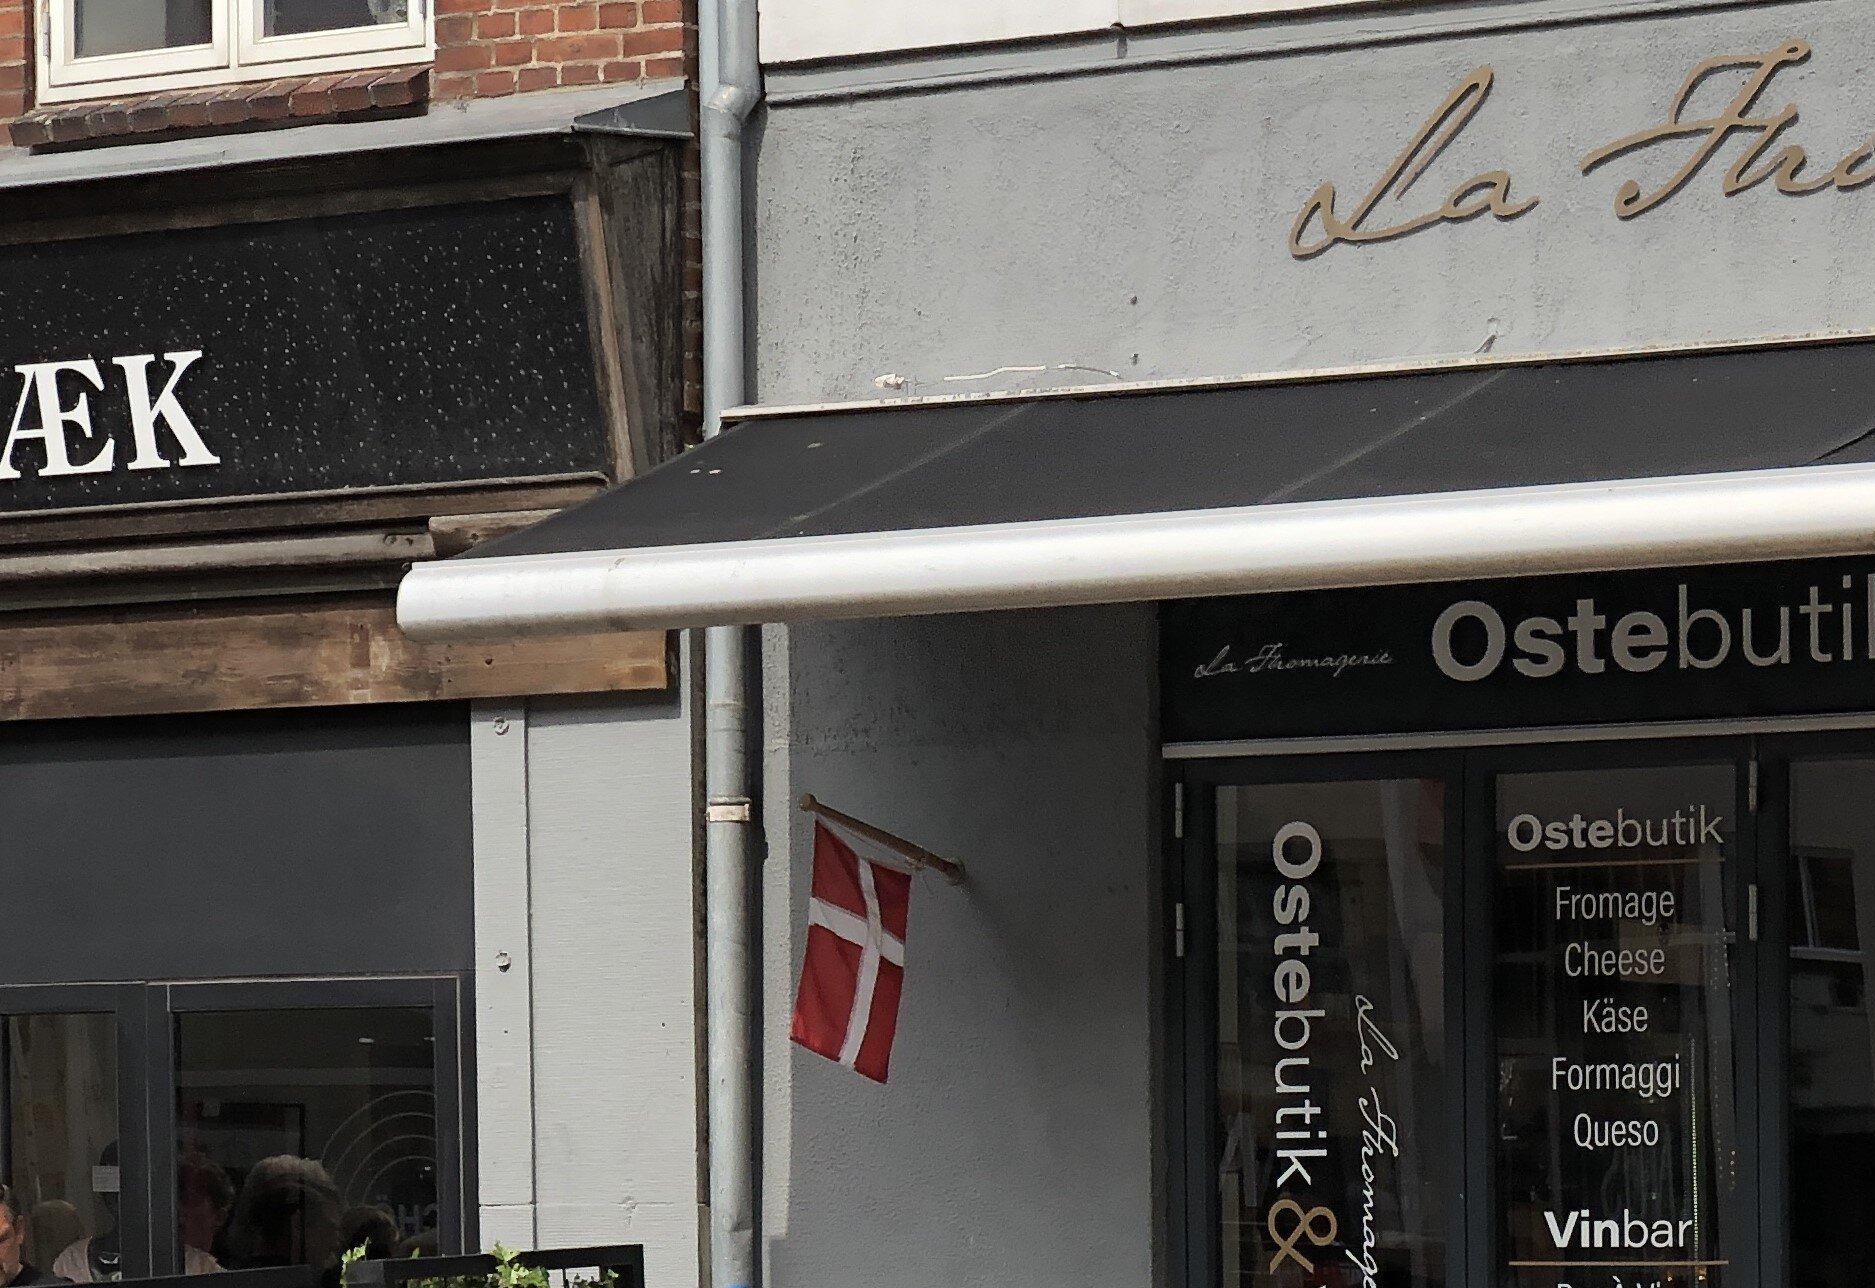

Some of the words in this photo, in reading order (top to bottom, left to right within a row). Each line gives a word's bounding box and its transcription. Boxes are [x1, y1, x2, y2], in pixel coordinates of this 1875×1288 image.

[1289, 64, 1541, 260] La
[1507, 803, 1725, 853] Ostebutik
[1554, 887, 1676, 926] Fromage
[1564, 942, 1666, 977] Cheese
[1271, 820, 1329, 1187] Ostebutik
[1582, 998, 1649, 1034] Käse
[1551, 1053, 1681, 1098] Formaggi
[1574, 1112, 1660, 1149] Queso
[1267, 1197, 1338, 1275] &
[1544, 1208, 1693, 1250] Vinbar
